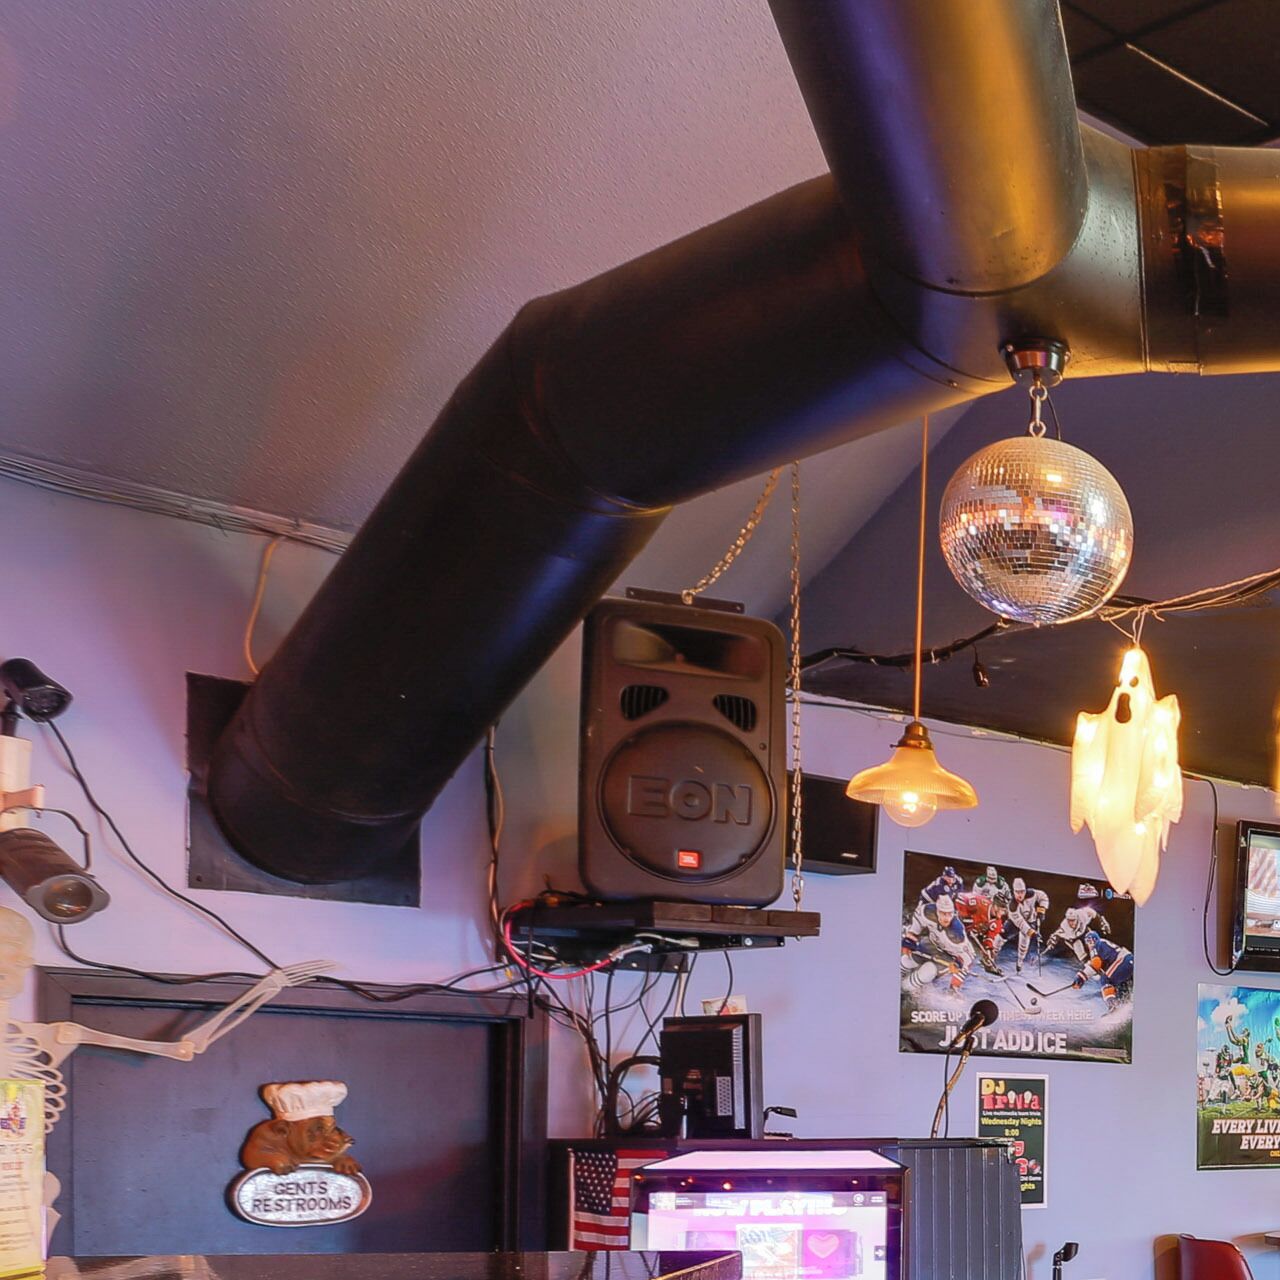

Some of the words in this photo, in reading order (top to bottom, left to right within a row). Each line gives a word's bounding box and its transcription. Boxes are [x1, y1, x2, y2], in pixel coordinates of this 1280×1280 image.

[627, 774, 752, 826] EON
[911, 1010, 946, 1023] SCORE
[948, 1011, 962, 1022] UP
[993, 1030, 1037, 1052] ADD
[1038, 1031, 1068, 1054] ICE
[981, 1079, 1006, 1096] DJ
[981, 1117, 1020, 1127] Wednesday
[1020, 1117, 1042, 1127] Nights
[1211, 1119, 1255, 1134] EVERY
[1240, 1135, 1280, 1150] EVERY
[274, 1181, 328, 1196] GENTS
[1020, 1182, 1036, 1192] ghts
[252, 1196, 352, 1213] RESTROOMS
